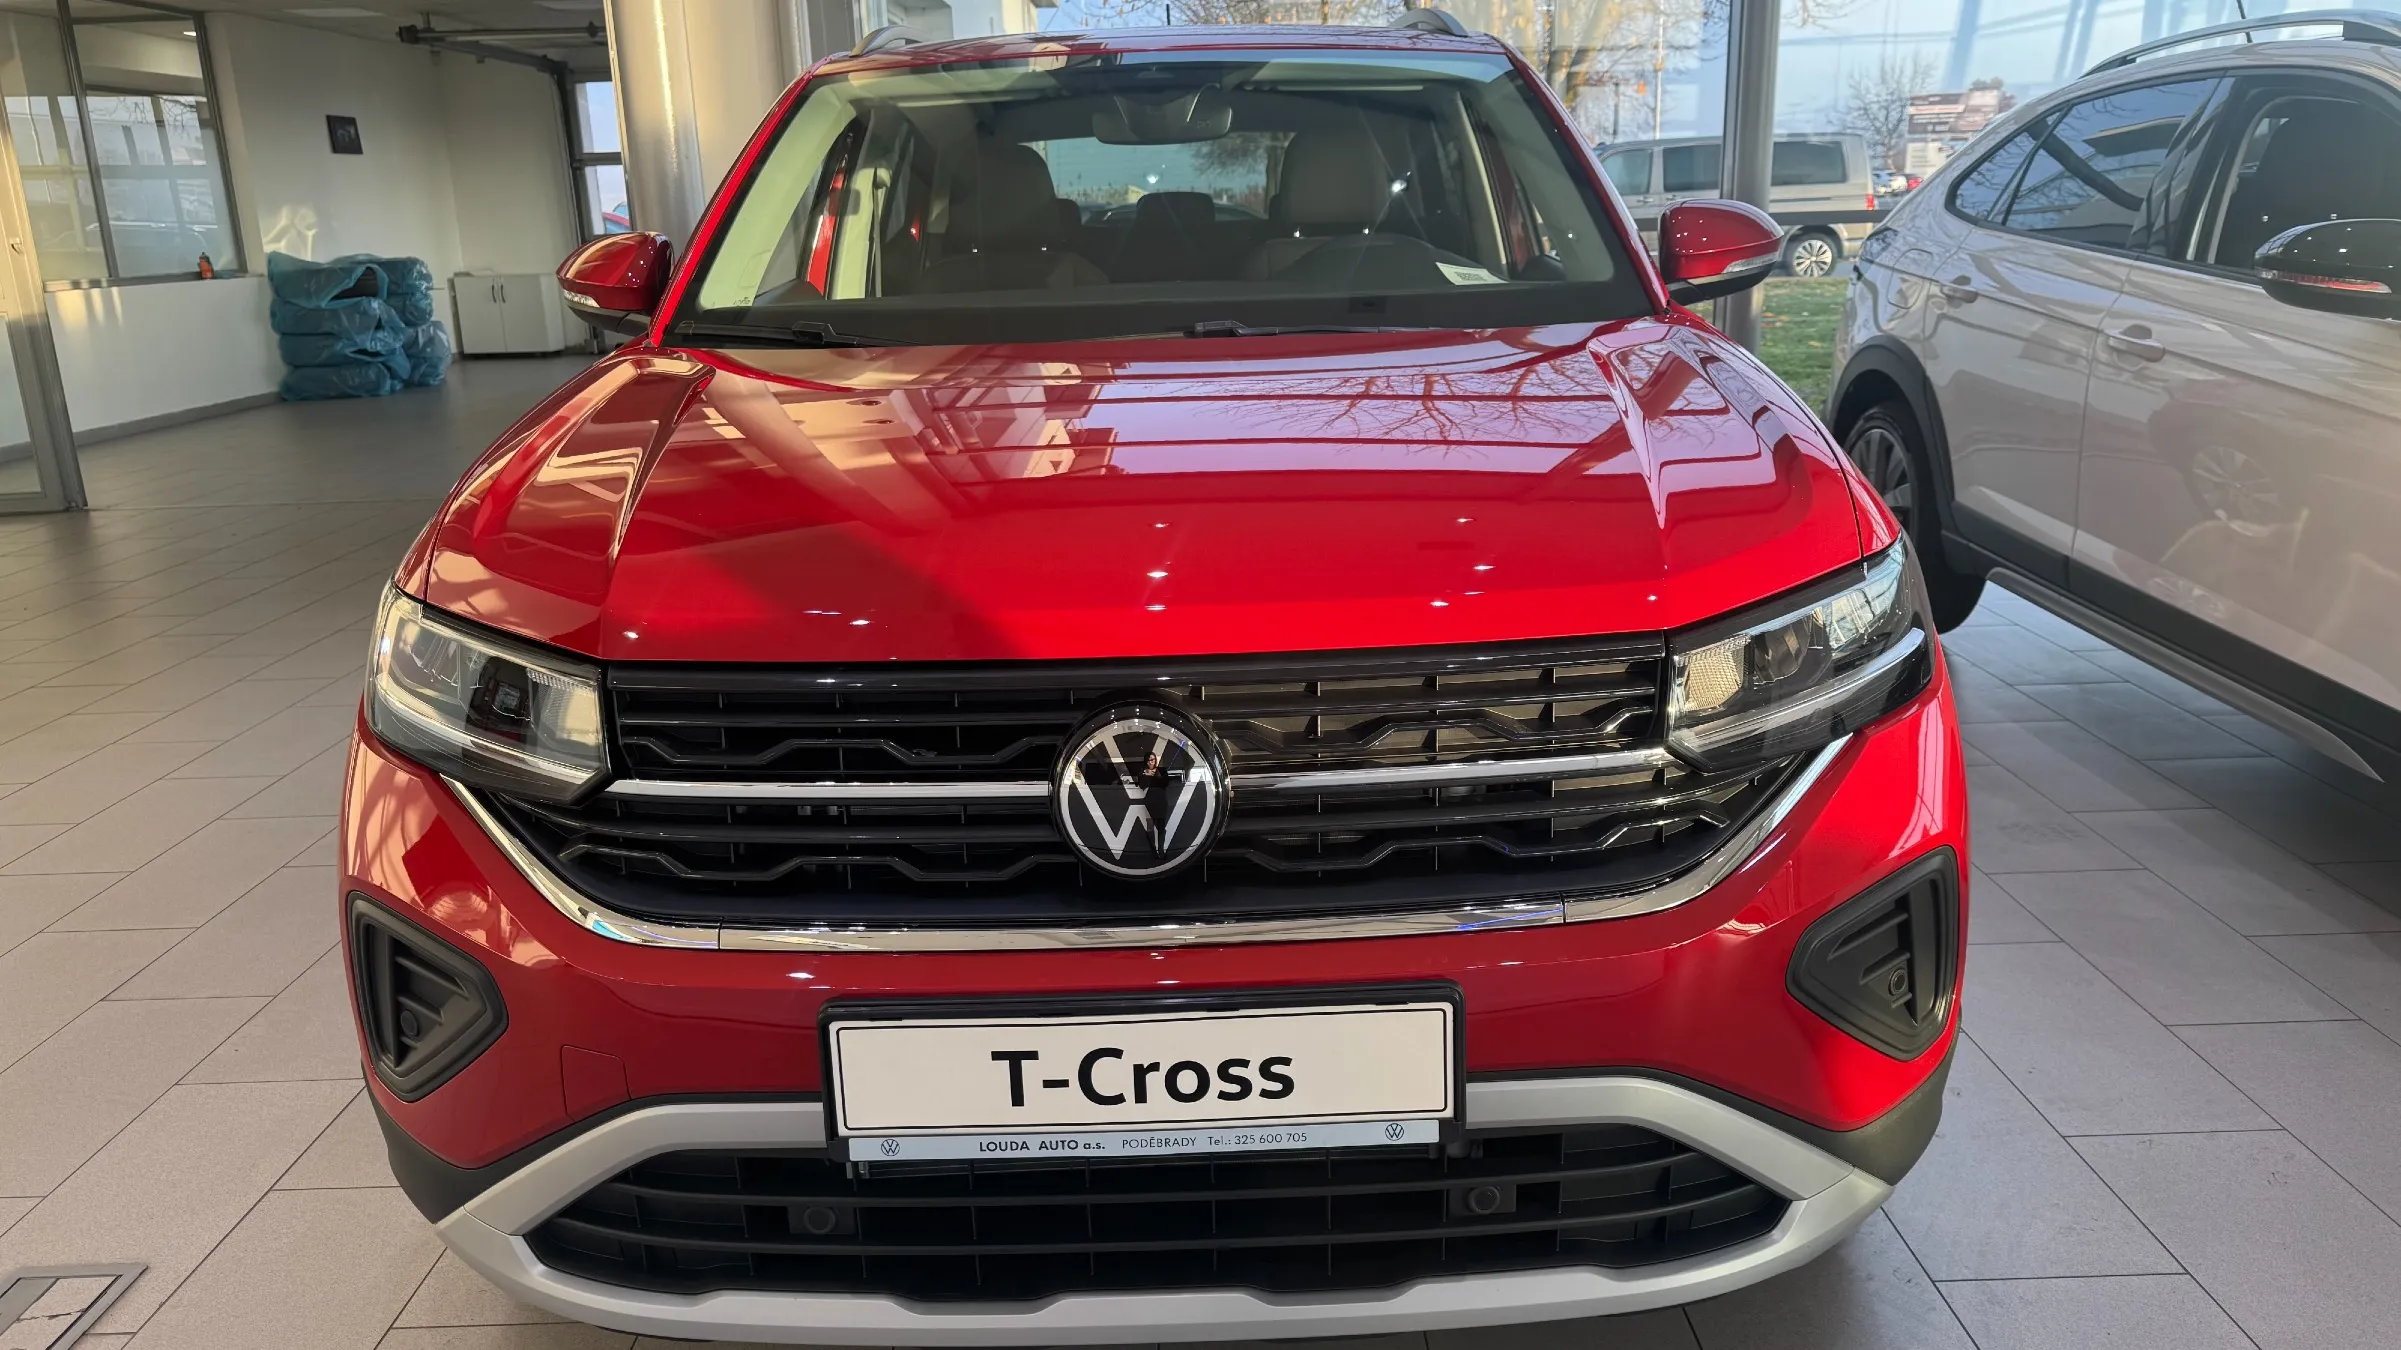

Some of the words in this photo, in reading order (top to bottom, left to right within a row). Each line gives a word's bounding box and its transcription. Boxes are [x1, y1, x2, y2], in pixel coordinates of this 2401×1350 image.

[1060, 719, 1216, 875] VW
[990, 1047, 1295, 1107] T-Cross
[979, 1140, 1031, 1152] LOUDA
[1038, 1139, 1079, 1151] AUTO
[1083, 1142, 1106, 1150] a.s.
[1122, 1136, 1197, 1149] PODĚBRADY
[1207, 1135, 1232, 1146] Tel.:
[1234, 1134, 1256, 1145] 325
[1259, 1133, 1283, 1144] 600
[1286, 1132, 1308, 1143] 705
